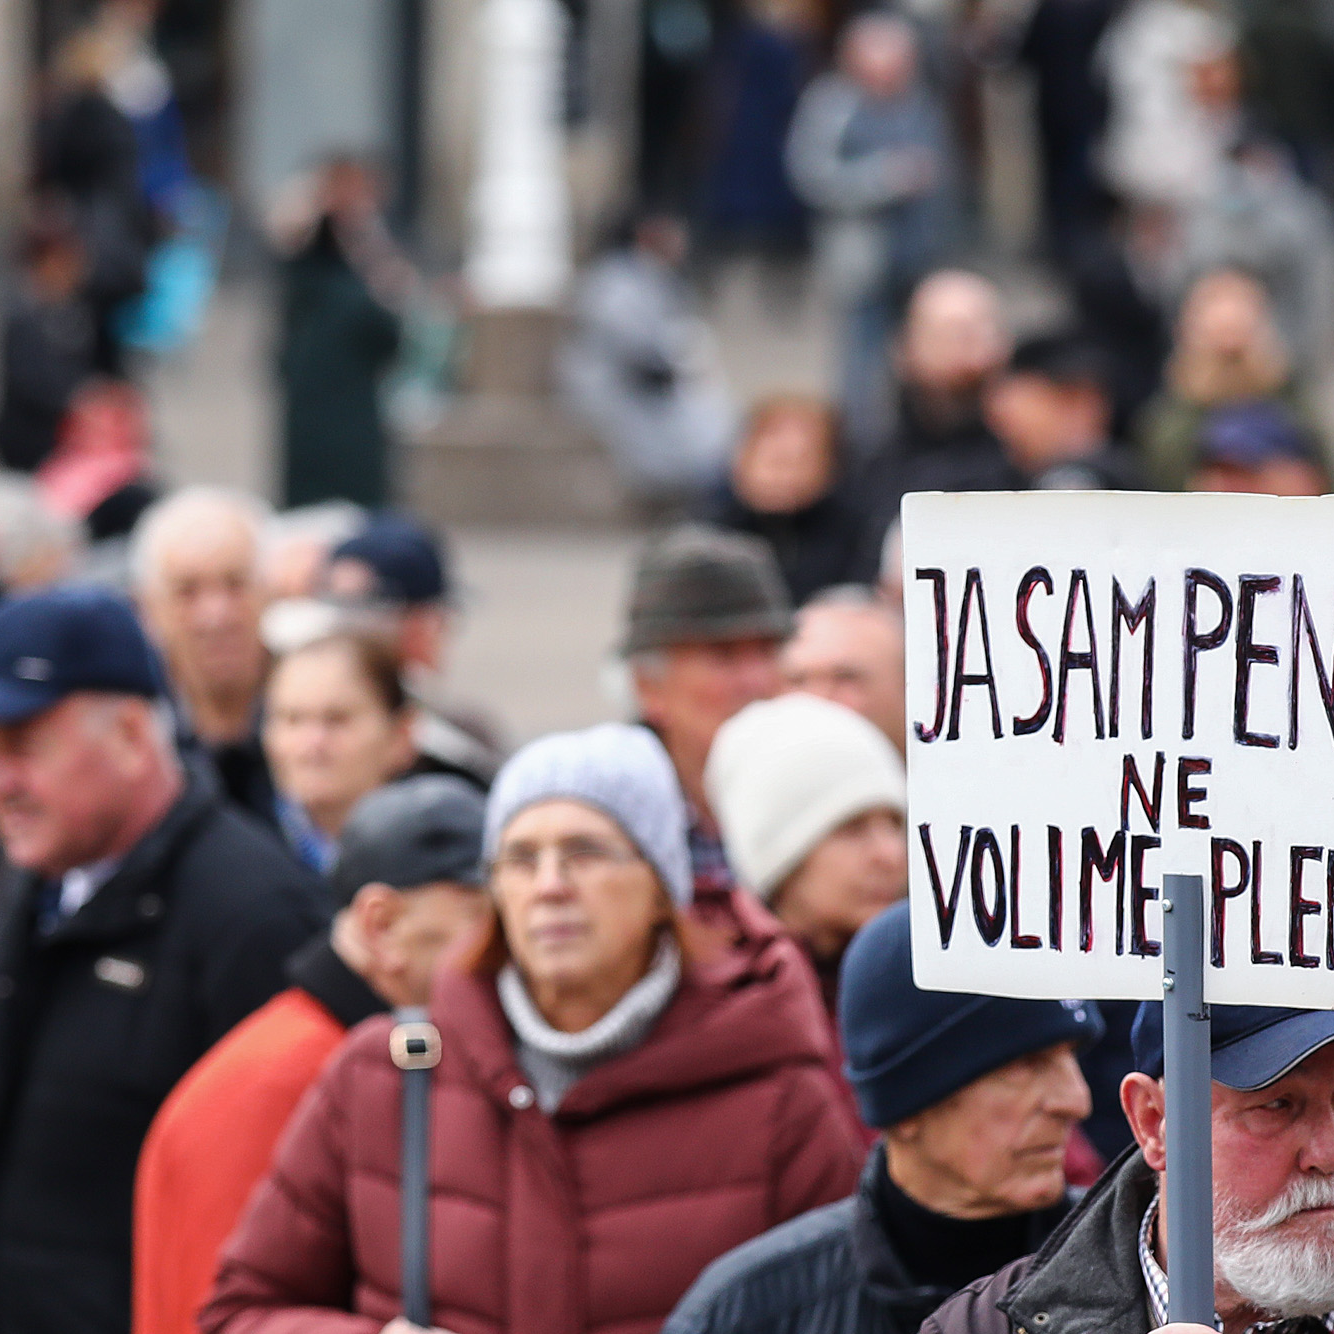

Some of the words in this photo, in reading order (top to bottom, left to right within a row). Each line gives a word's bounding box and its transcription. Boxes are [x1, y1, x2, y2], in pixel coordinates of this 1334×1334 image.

[913, 565, 1005, 742] JA
[1013, 565, 1157, 746] SAM
[1121, 751, 1213, 833] NE
